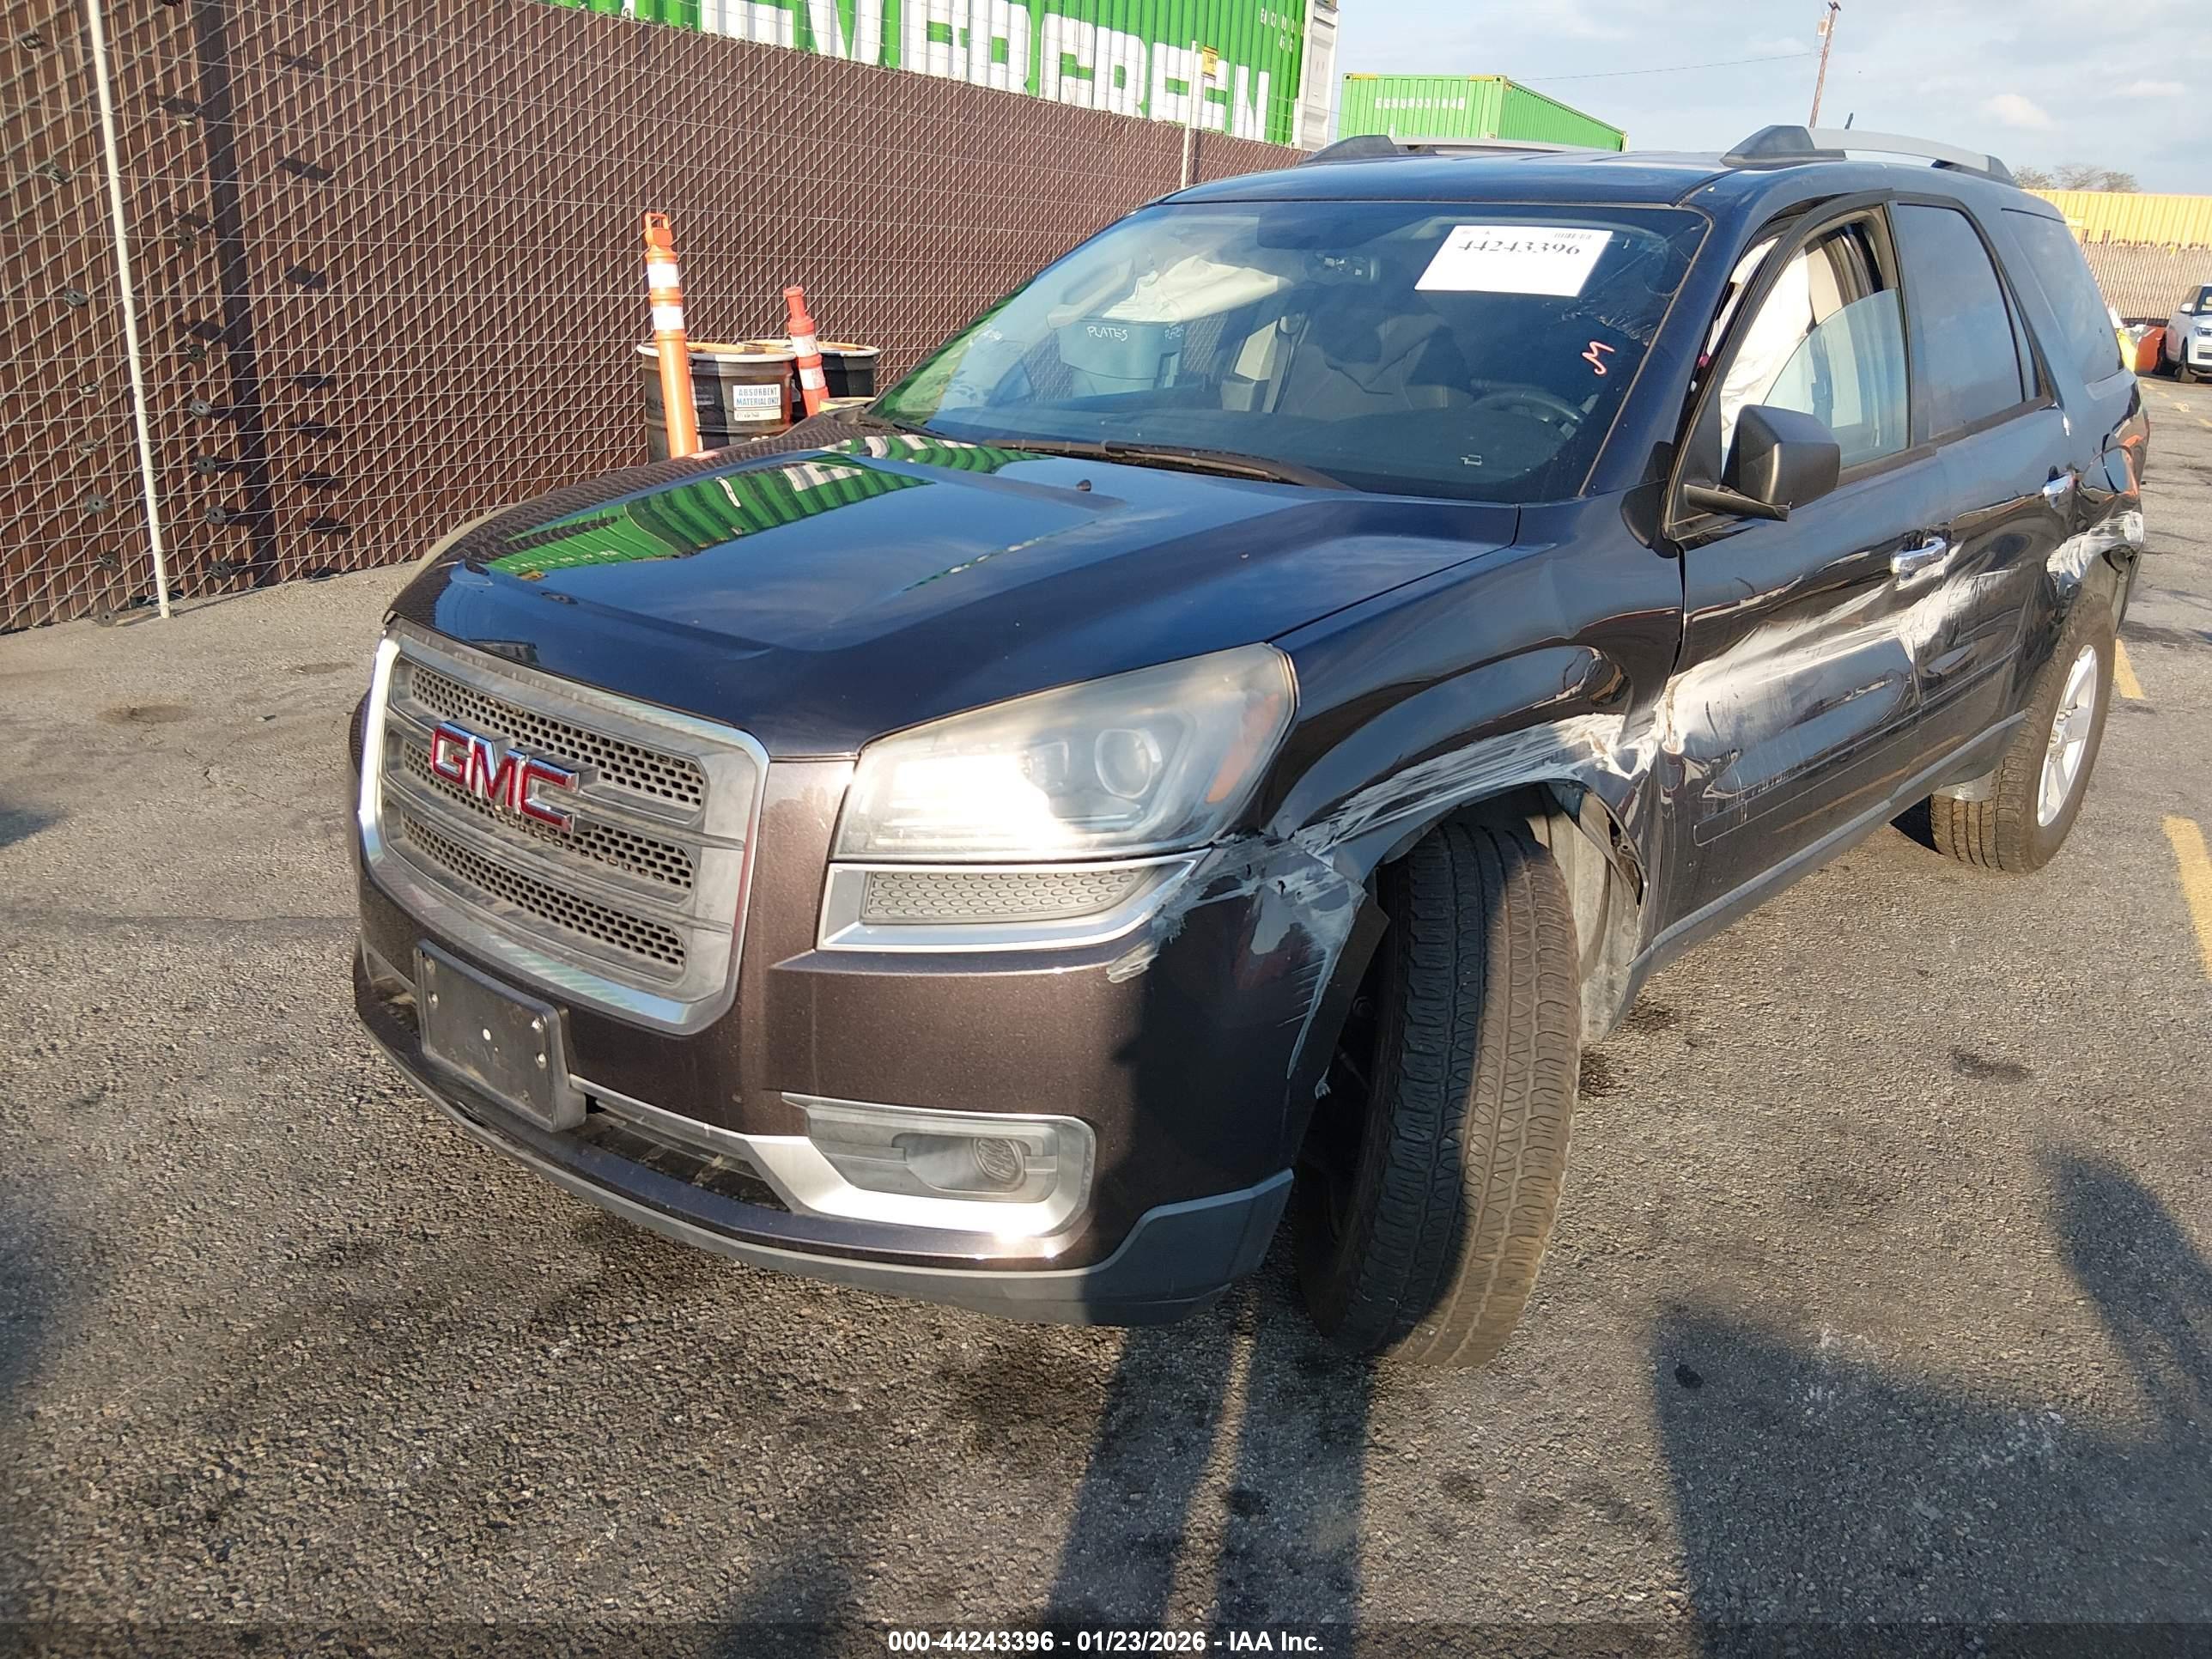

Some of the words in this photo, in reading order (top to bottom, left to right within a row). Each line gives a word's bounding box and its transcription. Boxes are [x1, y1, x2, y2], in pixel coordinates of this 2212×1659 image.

[738, 387, 777, 397] ABSORBENT
[736, 398, 766, 406] MATERIAL
[430, 720, 581, 835] GMC
